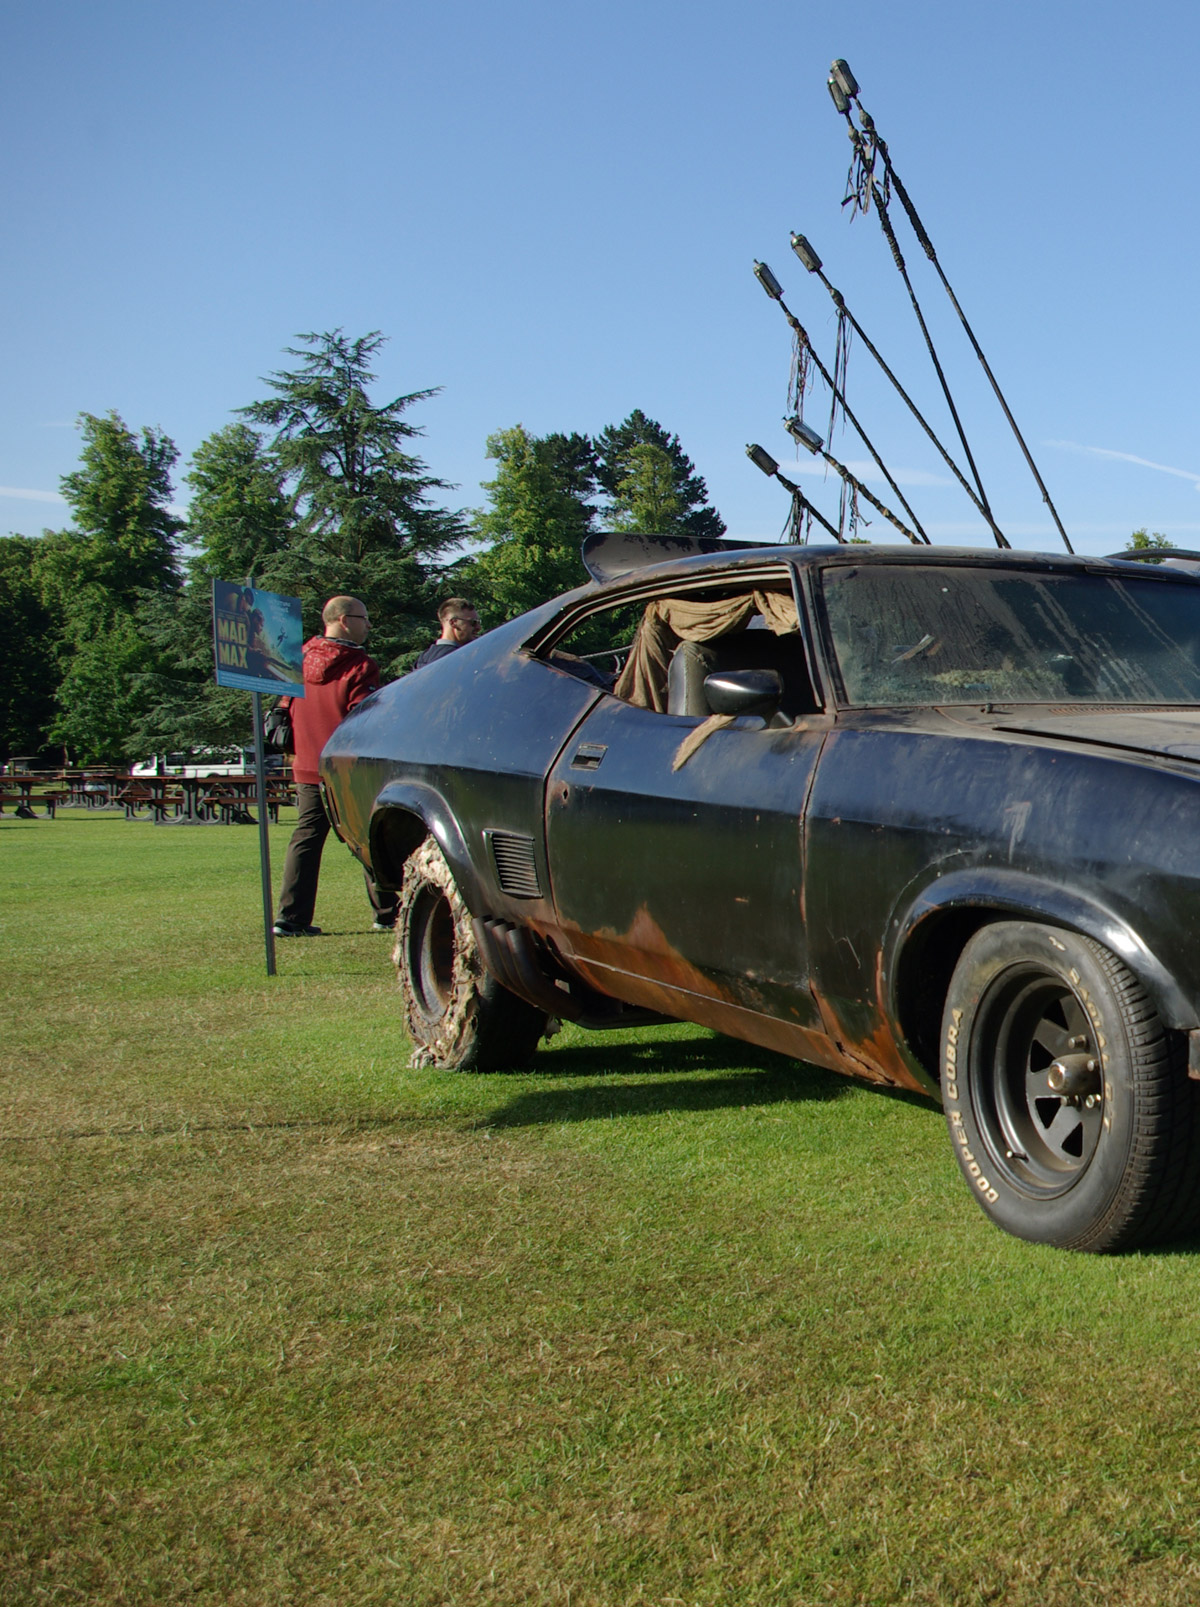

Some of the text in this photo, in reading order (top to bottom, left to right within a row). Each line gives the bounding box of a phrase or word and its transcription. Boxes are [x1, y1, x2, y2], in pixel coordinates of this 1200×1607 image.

[218, 619, 247, 645] MAD
[219, 643, 248, 668] MAX
[946, 1008, 1000, 1204] COOPER COBRA
